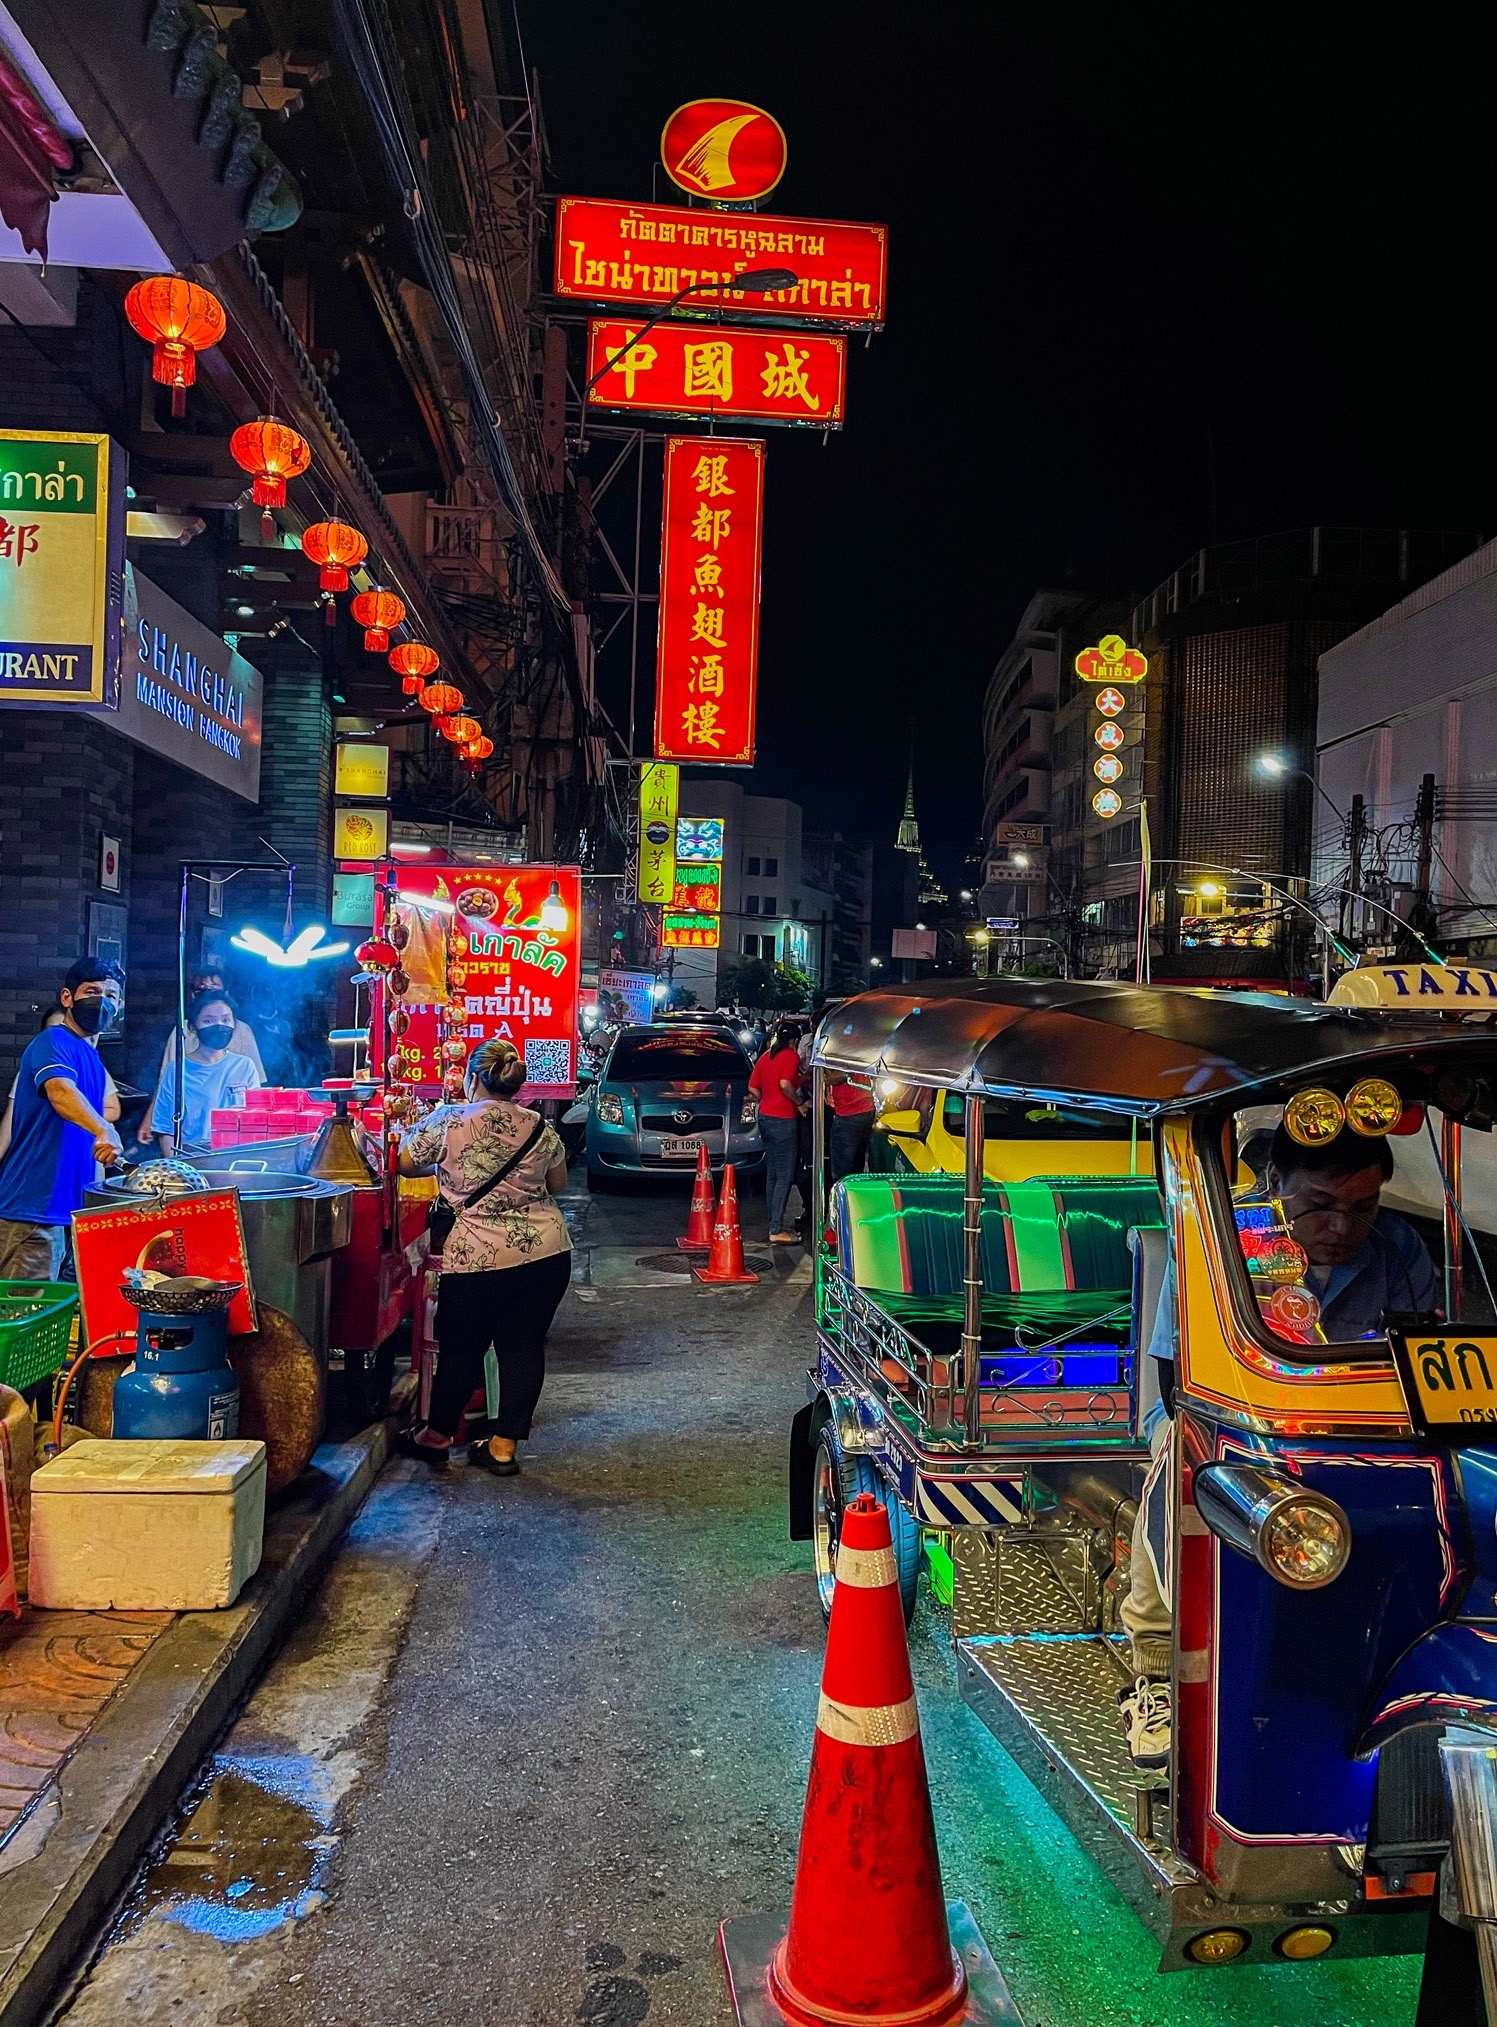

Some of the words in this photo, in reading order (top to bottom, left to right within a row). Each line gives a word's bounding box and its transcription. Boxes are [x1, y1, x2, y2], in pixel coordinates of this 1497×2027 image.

[605, 328, 820, 411] 中國城
[0, 460, 85, 502] กาล่า
[681, 454, 736, 750] 銀都魚翅酒樓
[138, 618, 243, 730] SHANGHAI
[136, 671, 196, 732] MANSION
[198, 713, 241, 760] BANGKOK
[346, 766, 386, 776] SHANGHAI
[343, 841, 358, 853] RED
[360, 842, 377, 854] ROSE
[336, 889, 373, 902] Burasa
[346, 902, 371, 912] Group
[1383, 967, 1497, 996] TAXI
[143, 1350, 160, 1361] 16.1
[1416, 1339, 1494, 1391] สก
